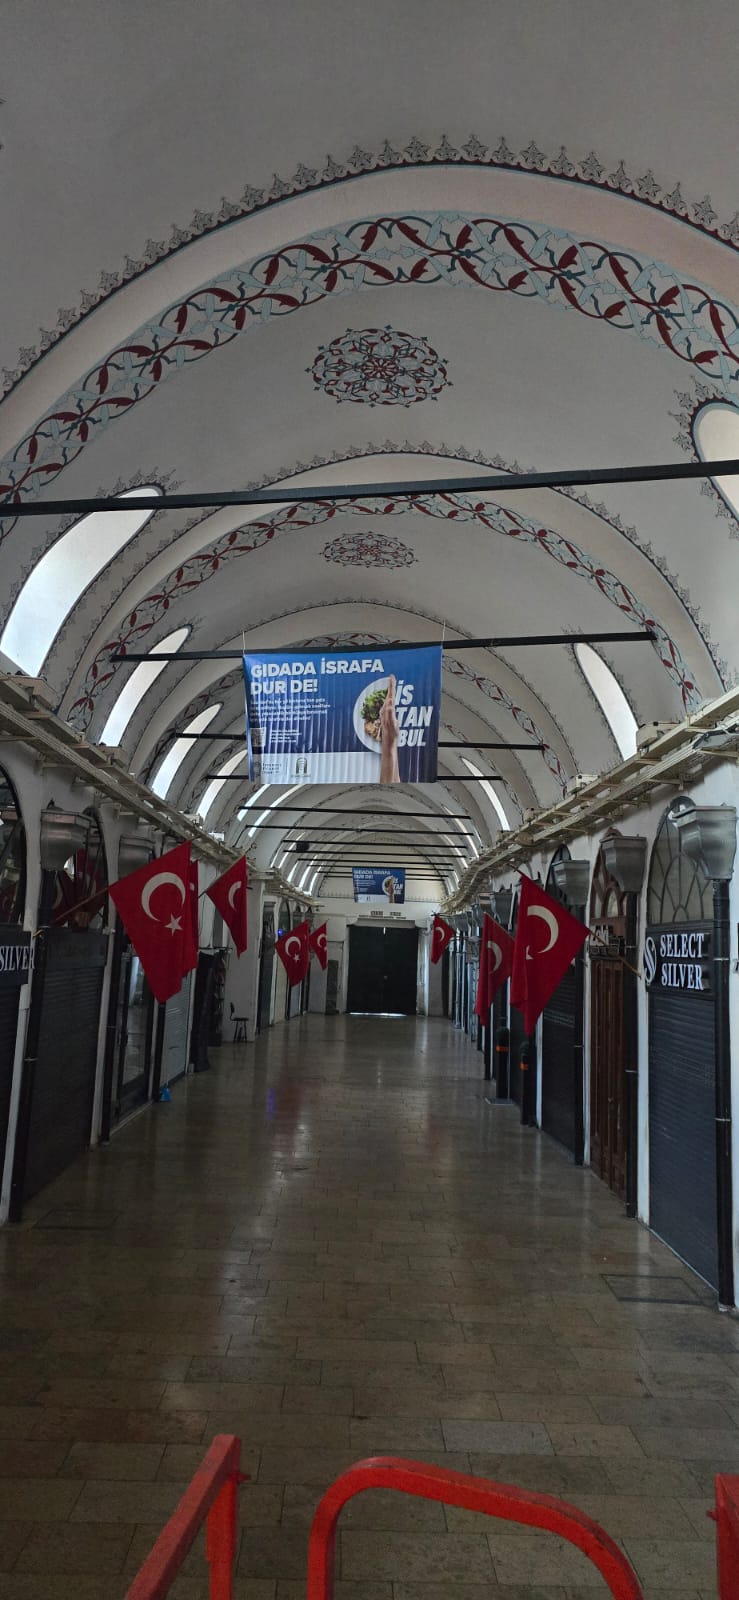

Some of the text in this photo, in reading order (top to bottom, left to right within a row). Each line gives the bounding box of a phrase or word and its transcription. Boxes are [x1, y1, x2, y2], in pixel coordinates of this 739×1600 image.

[251, 657, 384, 678] GIDADA İSRAFA
[251, 679, 318, 695] DUR DE!
[395, 680, 414, 705] İS
[395, 706, 433, 727] TAN
[397, 729, 426, 747] BUL
[660, 932, 704, 958] SELECT
[0, 945, 35, 971] SILVER
[661, 963, 704, 990] SILVER
